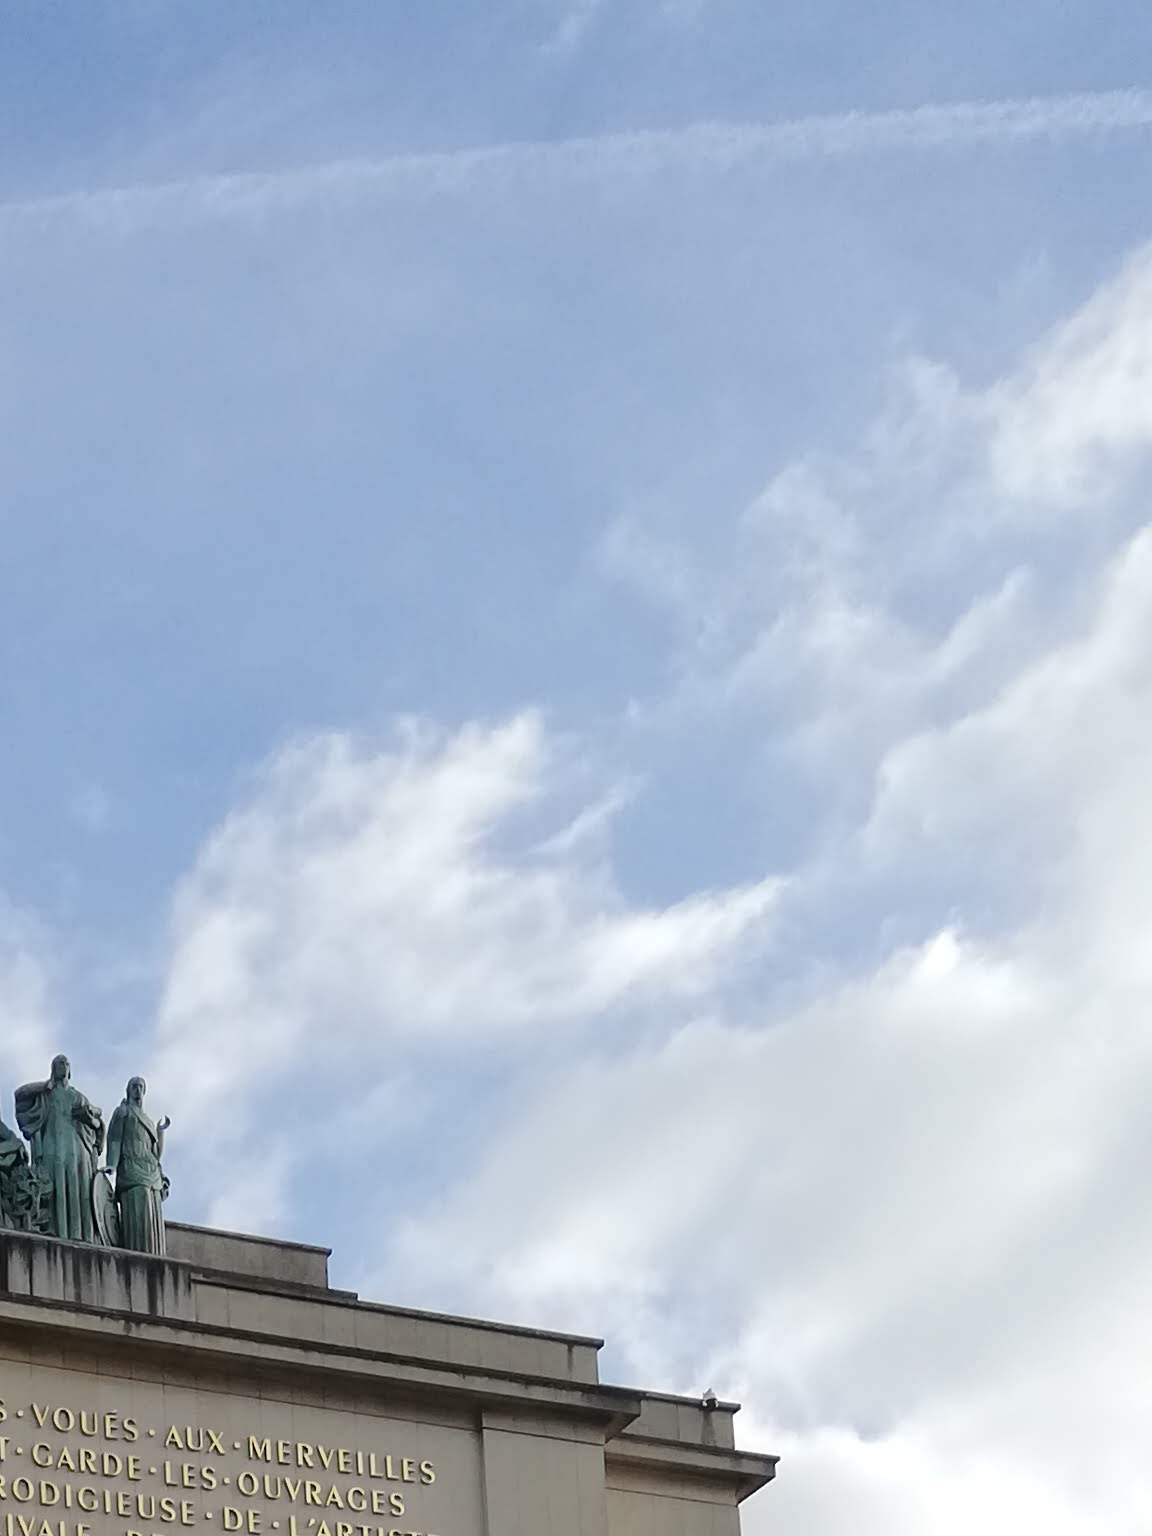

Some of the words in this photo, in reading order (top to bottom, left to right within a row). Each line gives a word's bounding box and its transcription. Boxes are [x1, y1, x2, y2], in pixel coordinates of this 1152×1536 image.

[32, 1443, 142, 1480] GARDE
[164, 1461, 218, 1491] LES
[238, 1472, 406, 1517] OUVRAGES
[33, 1402, 138, 1442] VOUÉS
[165, 1425, 225, 1455] AUX
[249, 1436, 437, 1485] MERVEILLES
[223, 1506, 264, 1535] DE
